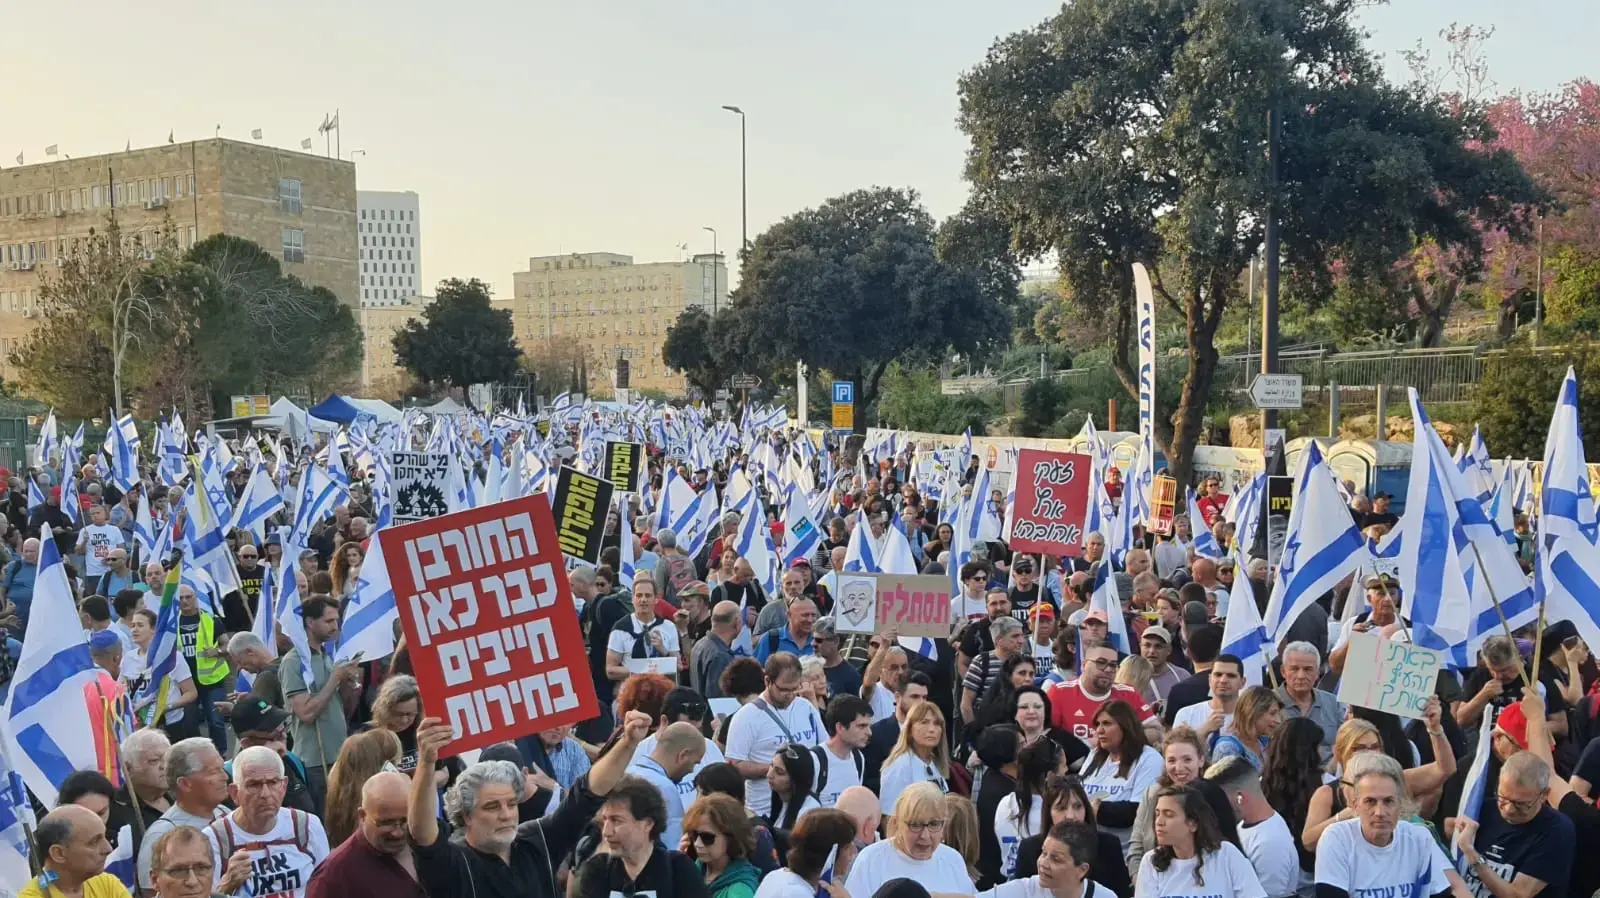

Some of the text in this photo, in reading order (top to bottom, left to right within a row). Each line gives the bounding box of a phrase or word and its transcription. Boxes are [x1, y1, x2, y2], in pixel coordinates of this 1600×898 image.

[393, 453, 449, 466] מי שהרס
[394, 466, 447, 480] לא יתקן
[558, 472, 600, 557] הופקרנו!
[1033, 487, 1066, 518] ארץ
[404, 512, 539, 592] החורבן
[1012, 518, 1081, 544] אהובה!
[408, 562, 558, 647] כבר כאן
[881, 583, 949, 625] תסתלק
[437, 617, 560, 687] חייבים
[445, 667, 579, 741] בחירות
